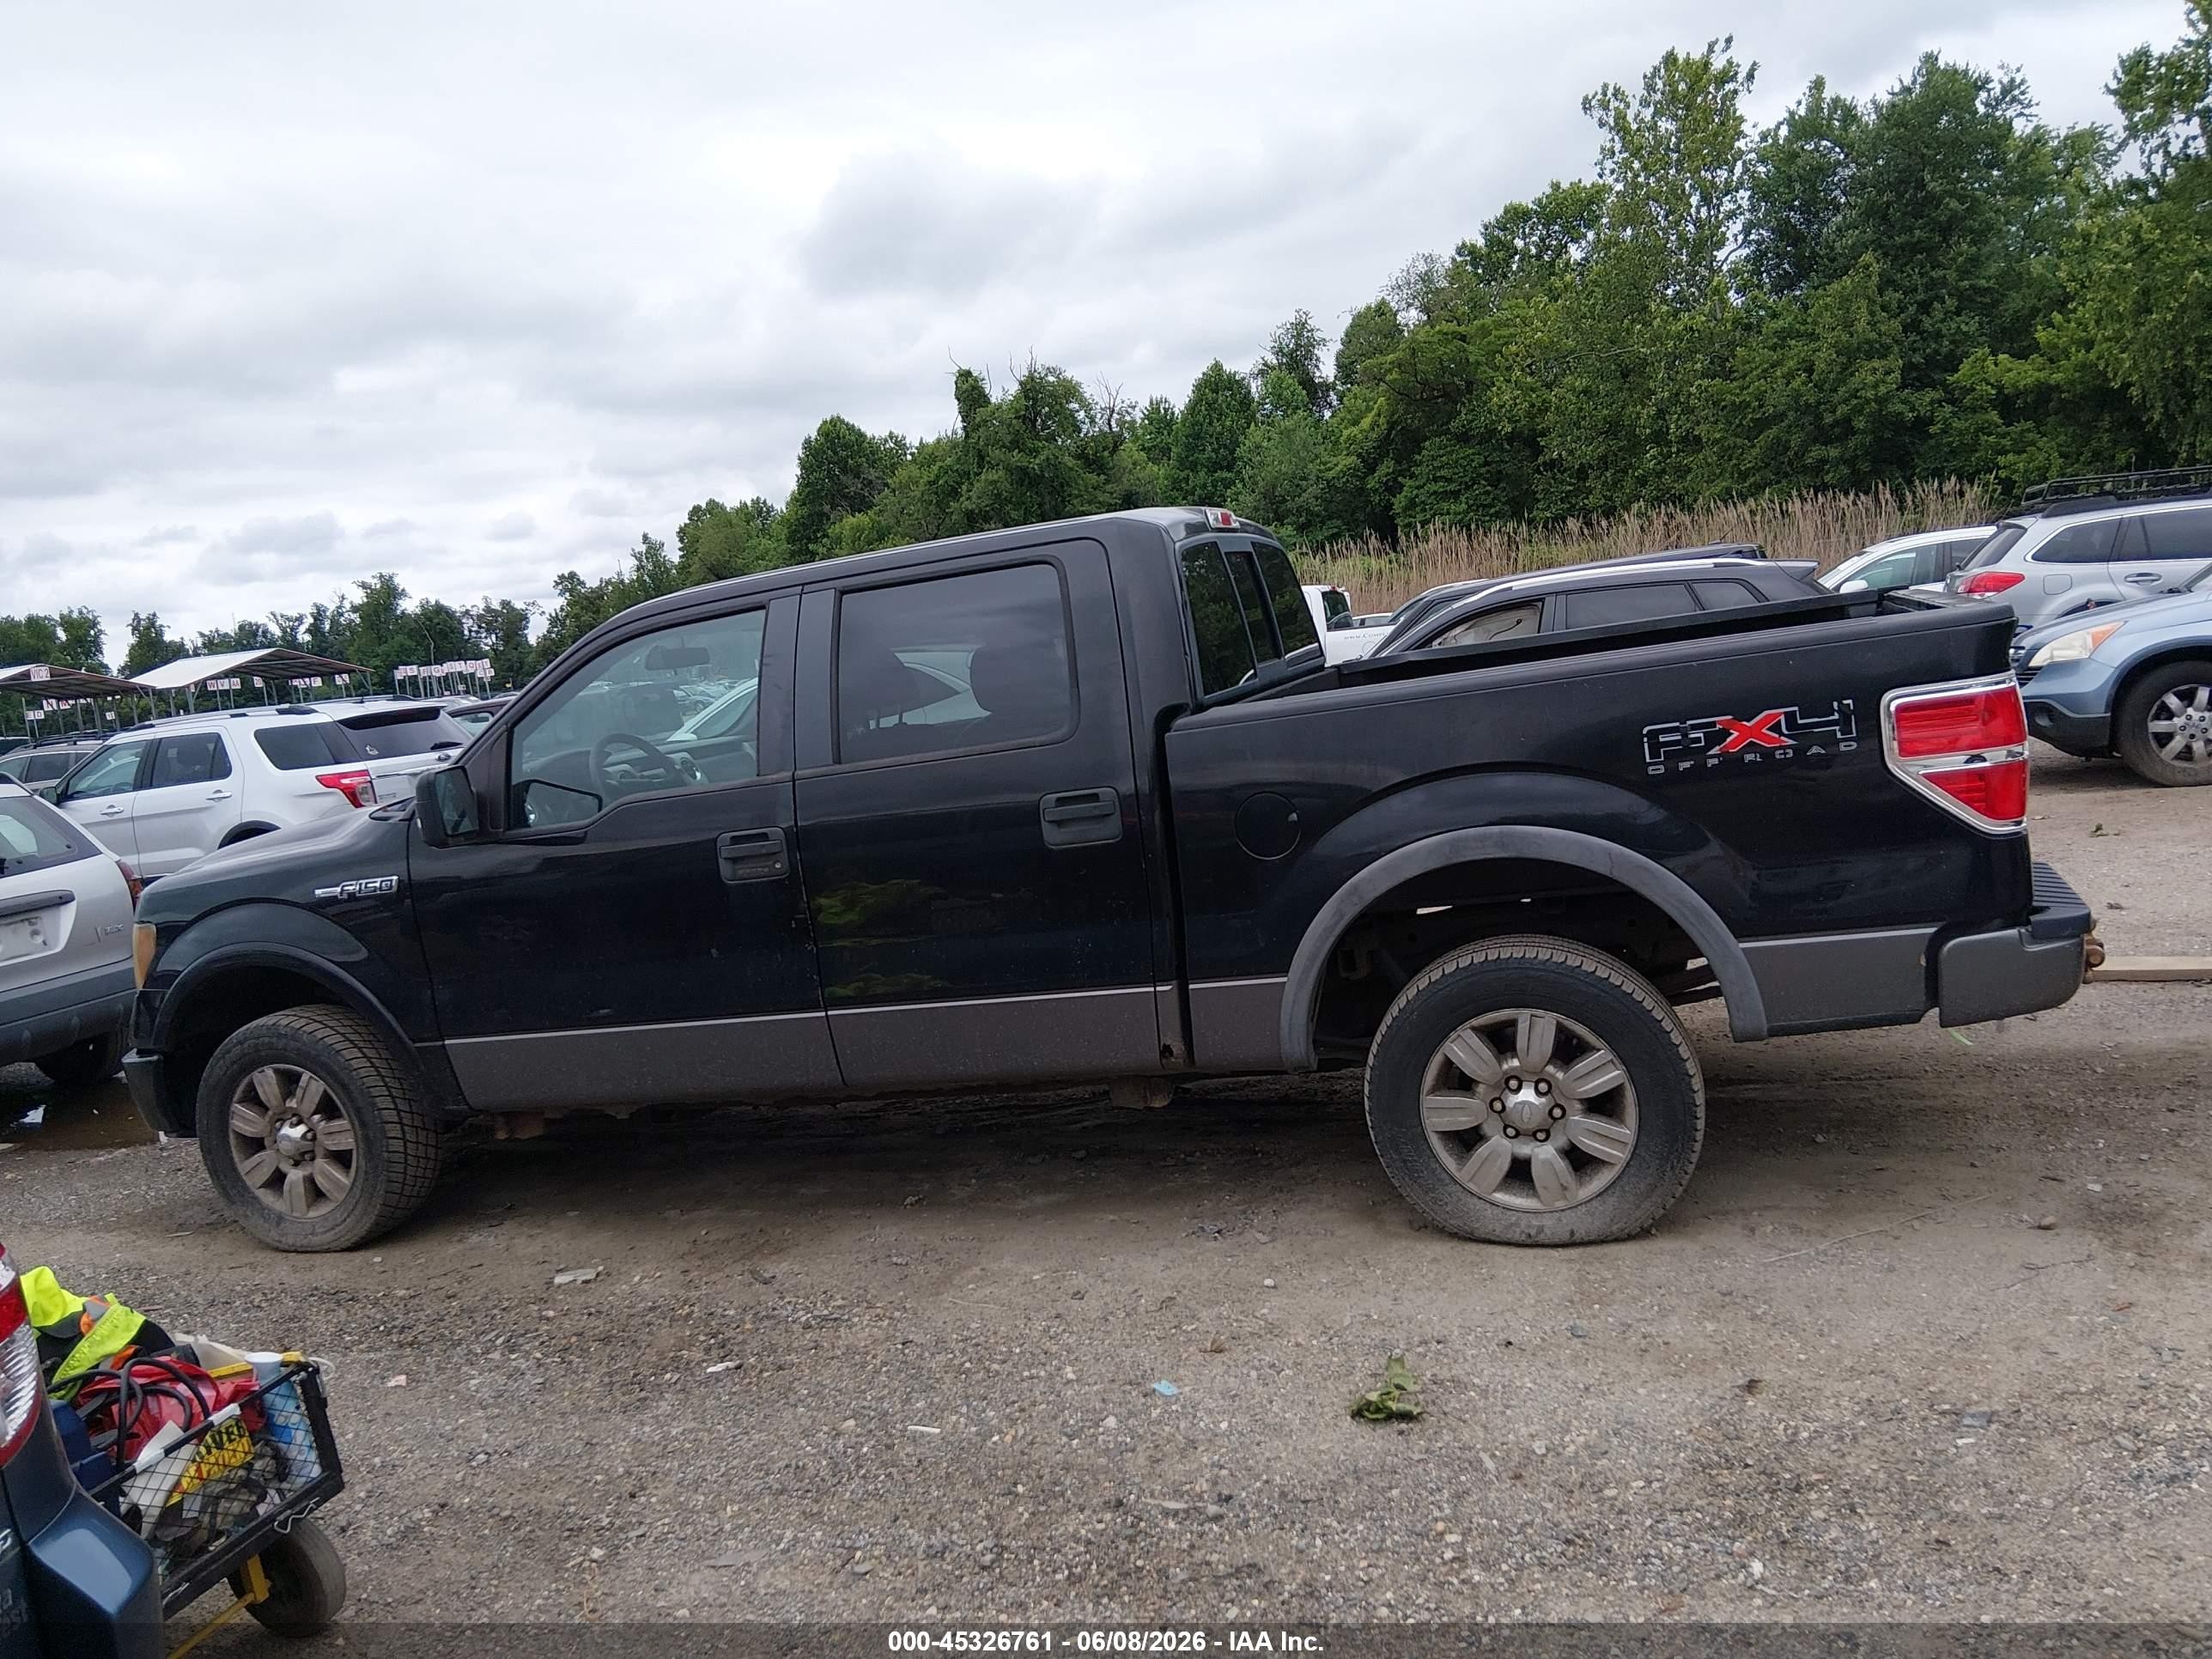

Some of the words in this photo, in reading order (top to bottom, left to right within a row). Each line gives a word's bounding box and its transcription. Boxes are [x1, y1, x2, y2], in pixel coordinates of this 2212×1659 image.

[31, 669, 44, 679] VIC
[45, 668, 50, 678] 2
[1643, 699, 1856, 763] FX4
